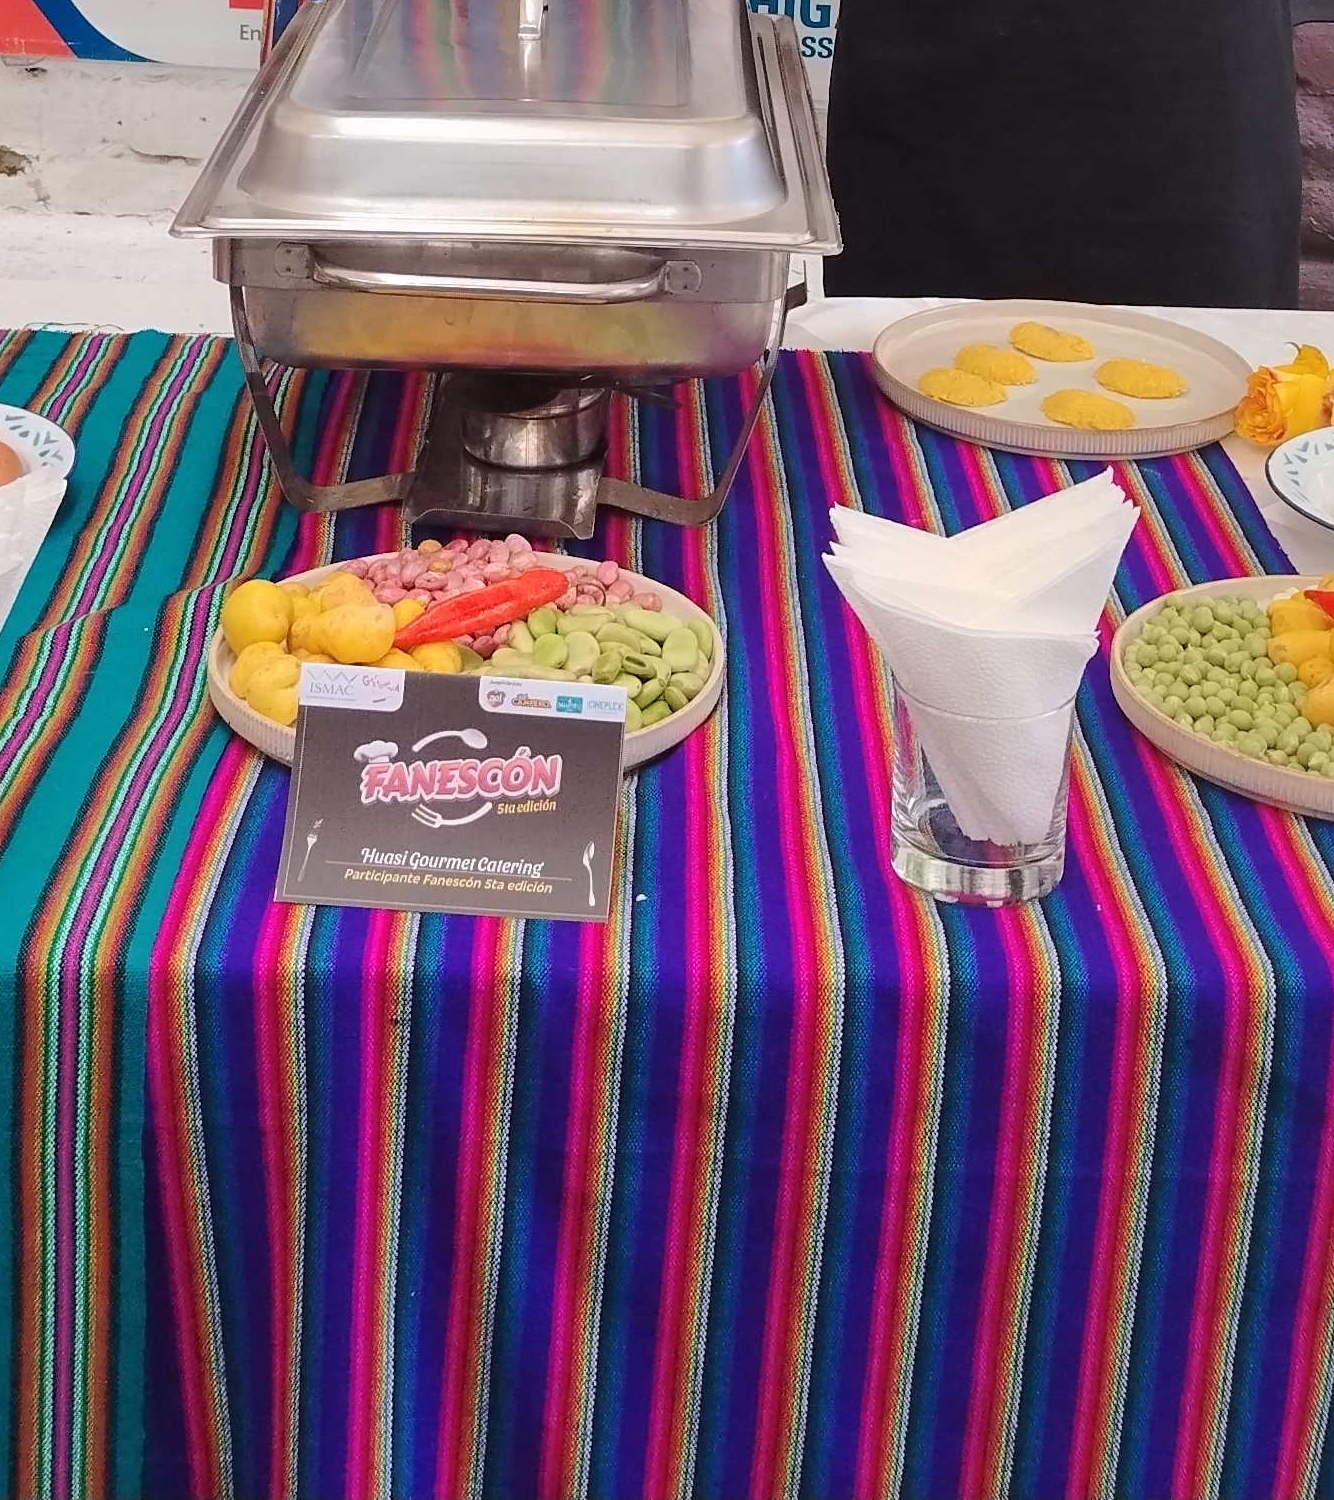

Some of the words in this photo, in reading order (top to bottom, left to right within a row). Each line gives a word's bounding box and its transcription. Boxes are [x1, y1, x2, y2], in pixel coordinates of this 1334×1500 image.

[309, 682, 354, 696] ISMAC
[361, 746, 563, 804] FANESCÓN
[497, 802, 515, 815] 5ta
[517, 799, 557, 813] edición
[361, 847, 408, 866] Huasi
[409, 851, 476, 870] Gourmet
[477, 856, 545, 878] Catering
[344, 868, 420, 885] Participante
[423, 873, 481, 889] Fanescón
[484, 878, 504, 891] 5ta
[507, 880, 553, 894] edición
